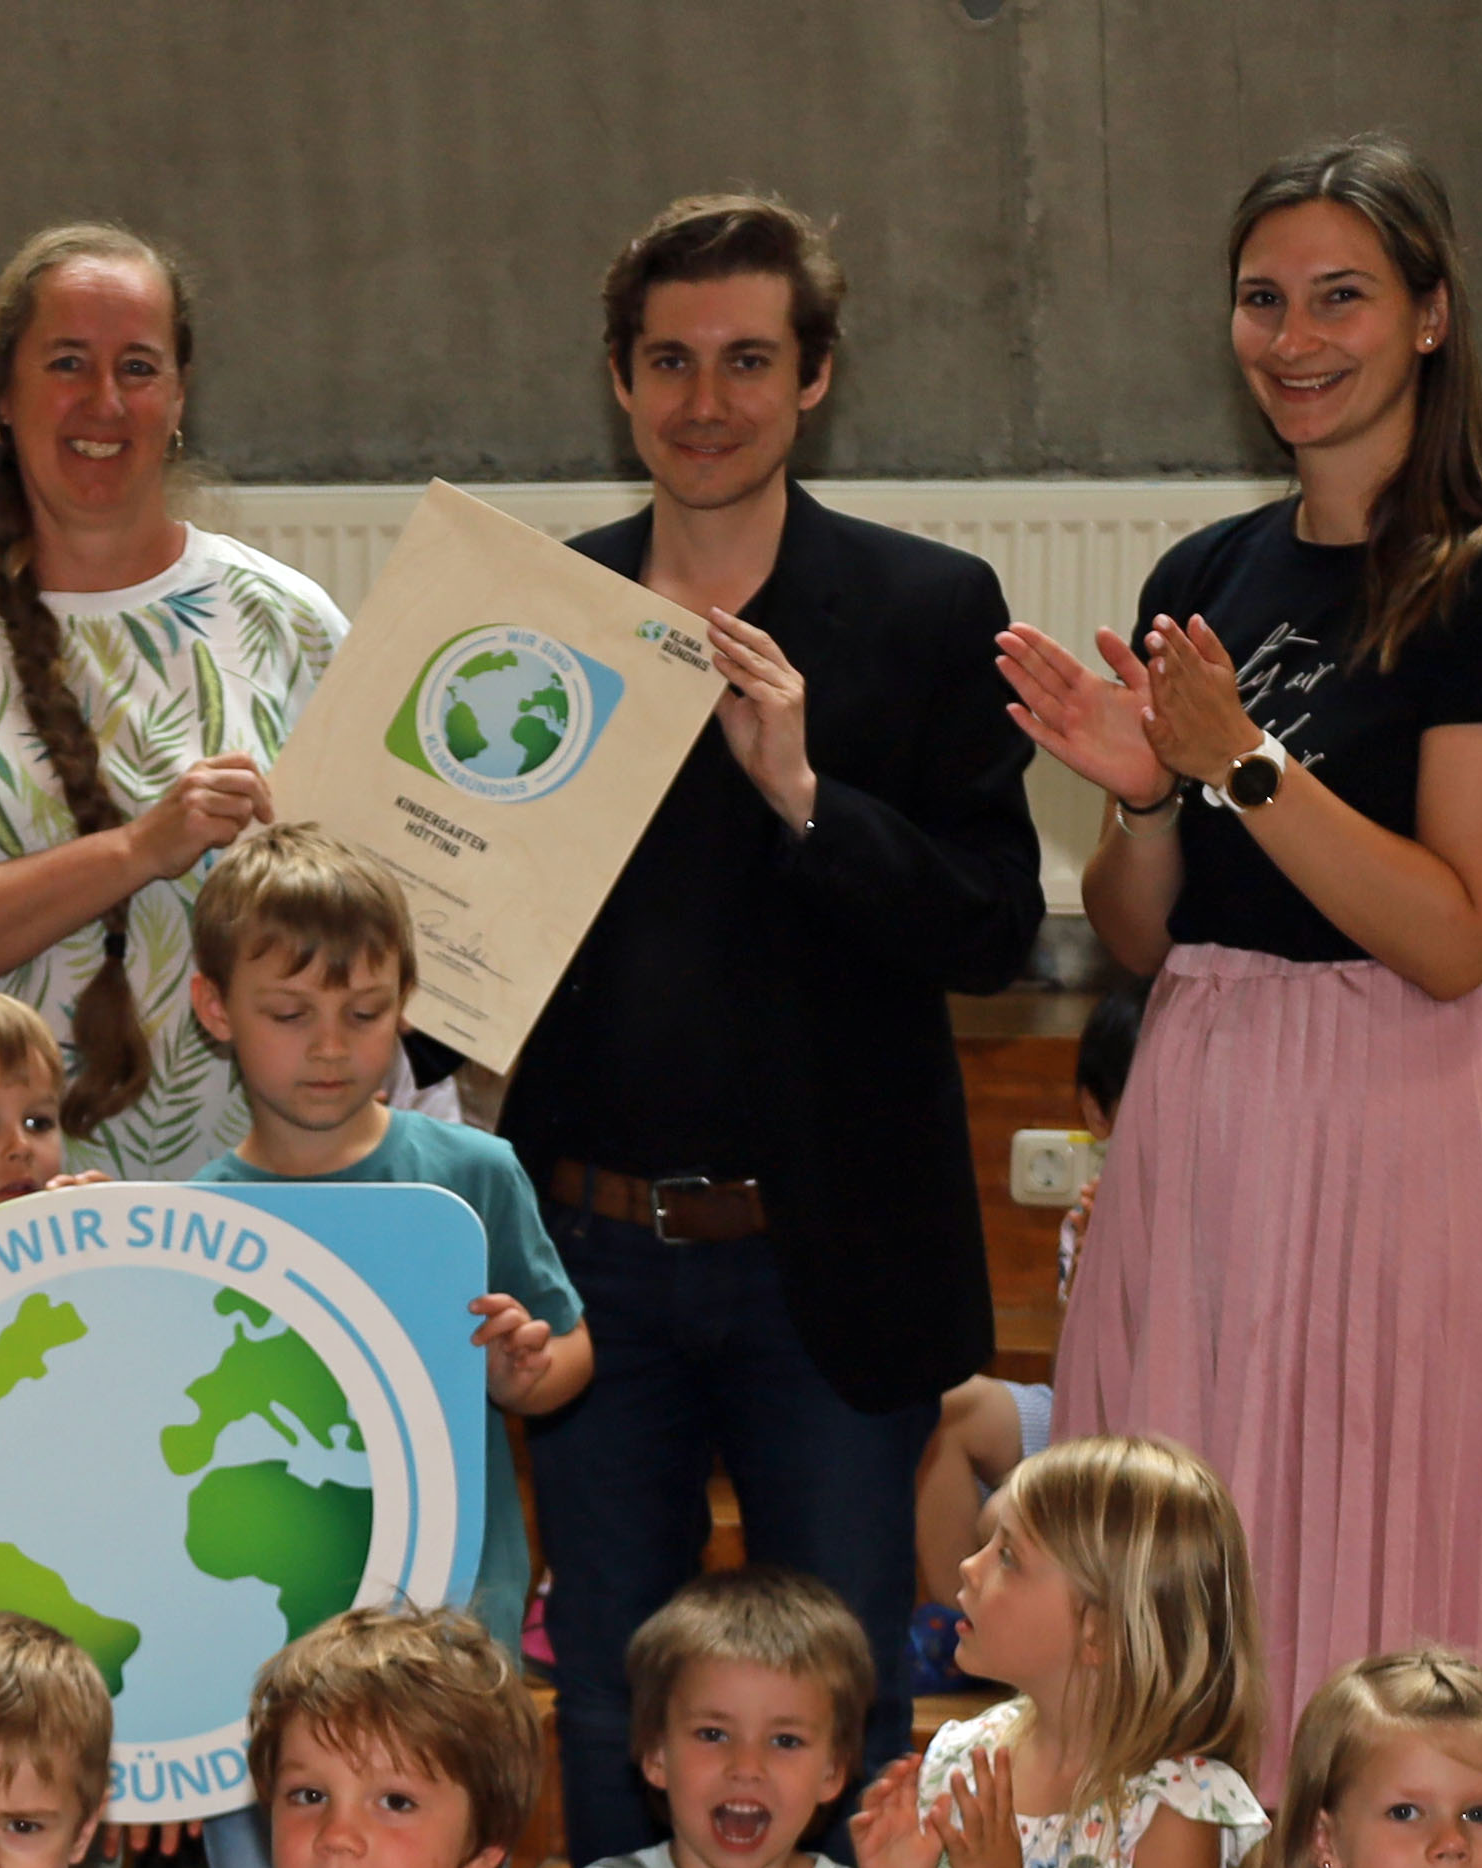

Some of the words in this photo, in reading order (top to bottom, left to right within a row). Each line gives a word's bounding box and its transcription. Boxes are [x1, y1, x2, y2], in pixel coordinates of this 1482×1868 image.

[394, 794, 490, 852] KINDERGARTEN
[404, 819, 461, 858] HÖTTING
[126, 1205, 269, 1273] SIND
